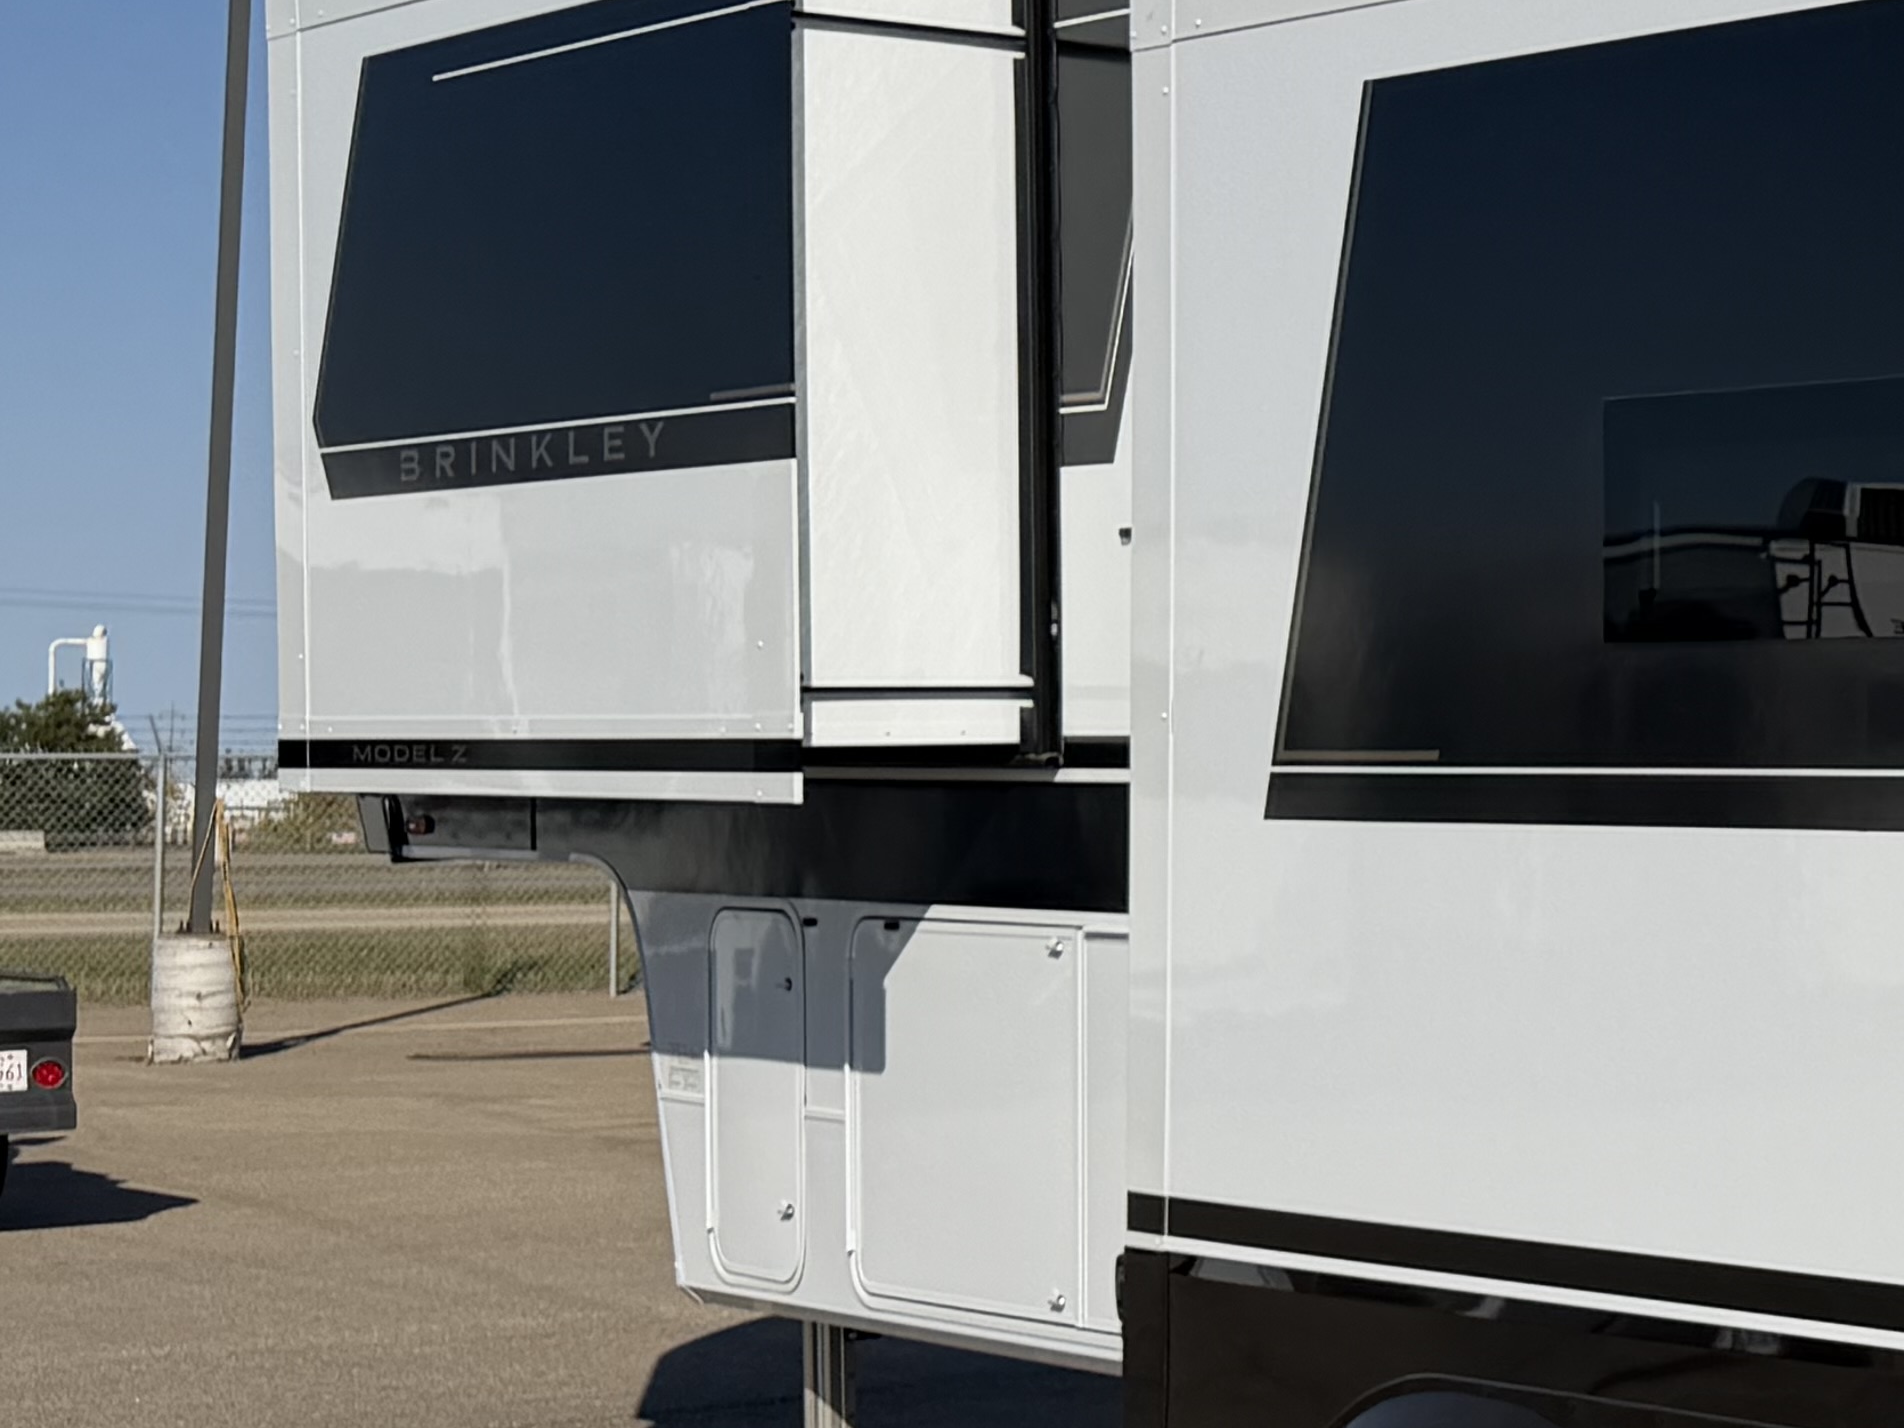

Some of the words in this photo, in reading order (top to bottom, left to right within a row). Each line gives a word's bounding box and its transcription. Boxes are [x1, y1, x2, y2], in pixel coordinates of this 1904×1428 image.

[399, 420, 665, 483] BRINKLEY
[351, 743, 445, 764] MODEL
[450, 744, 468, 764] Z
